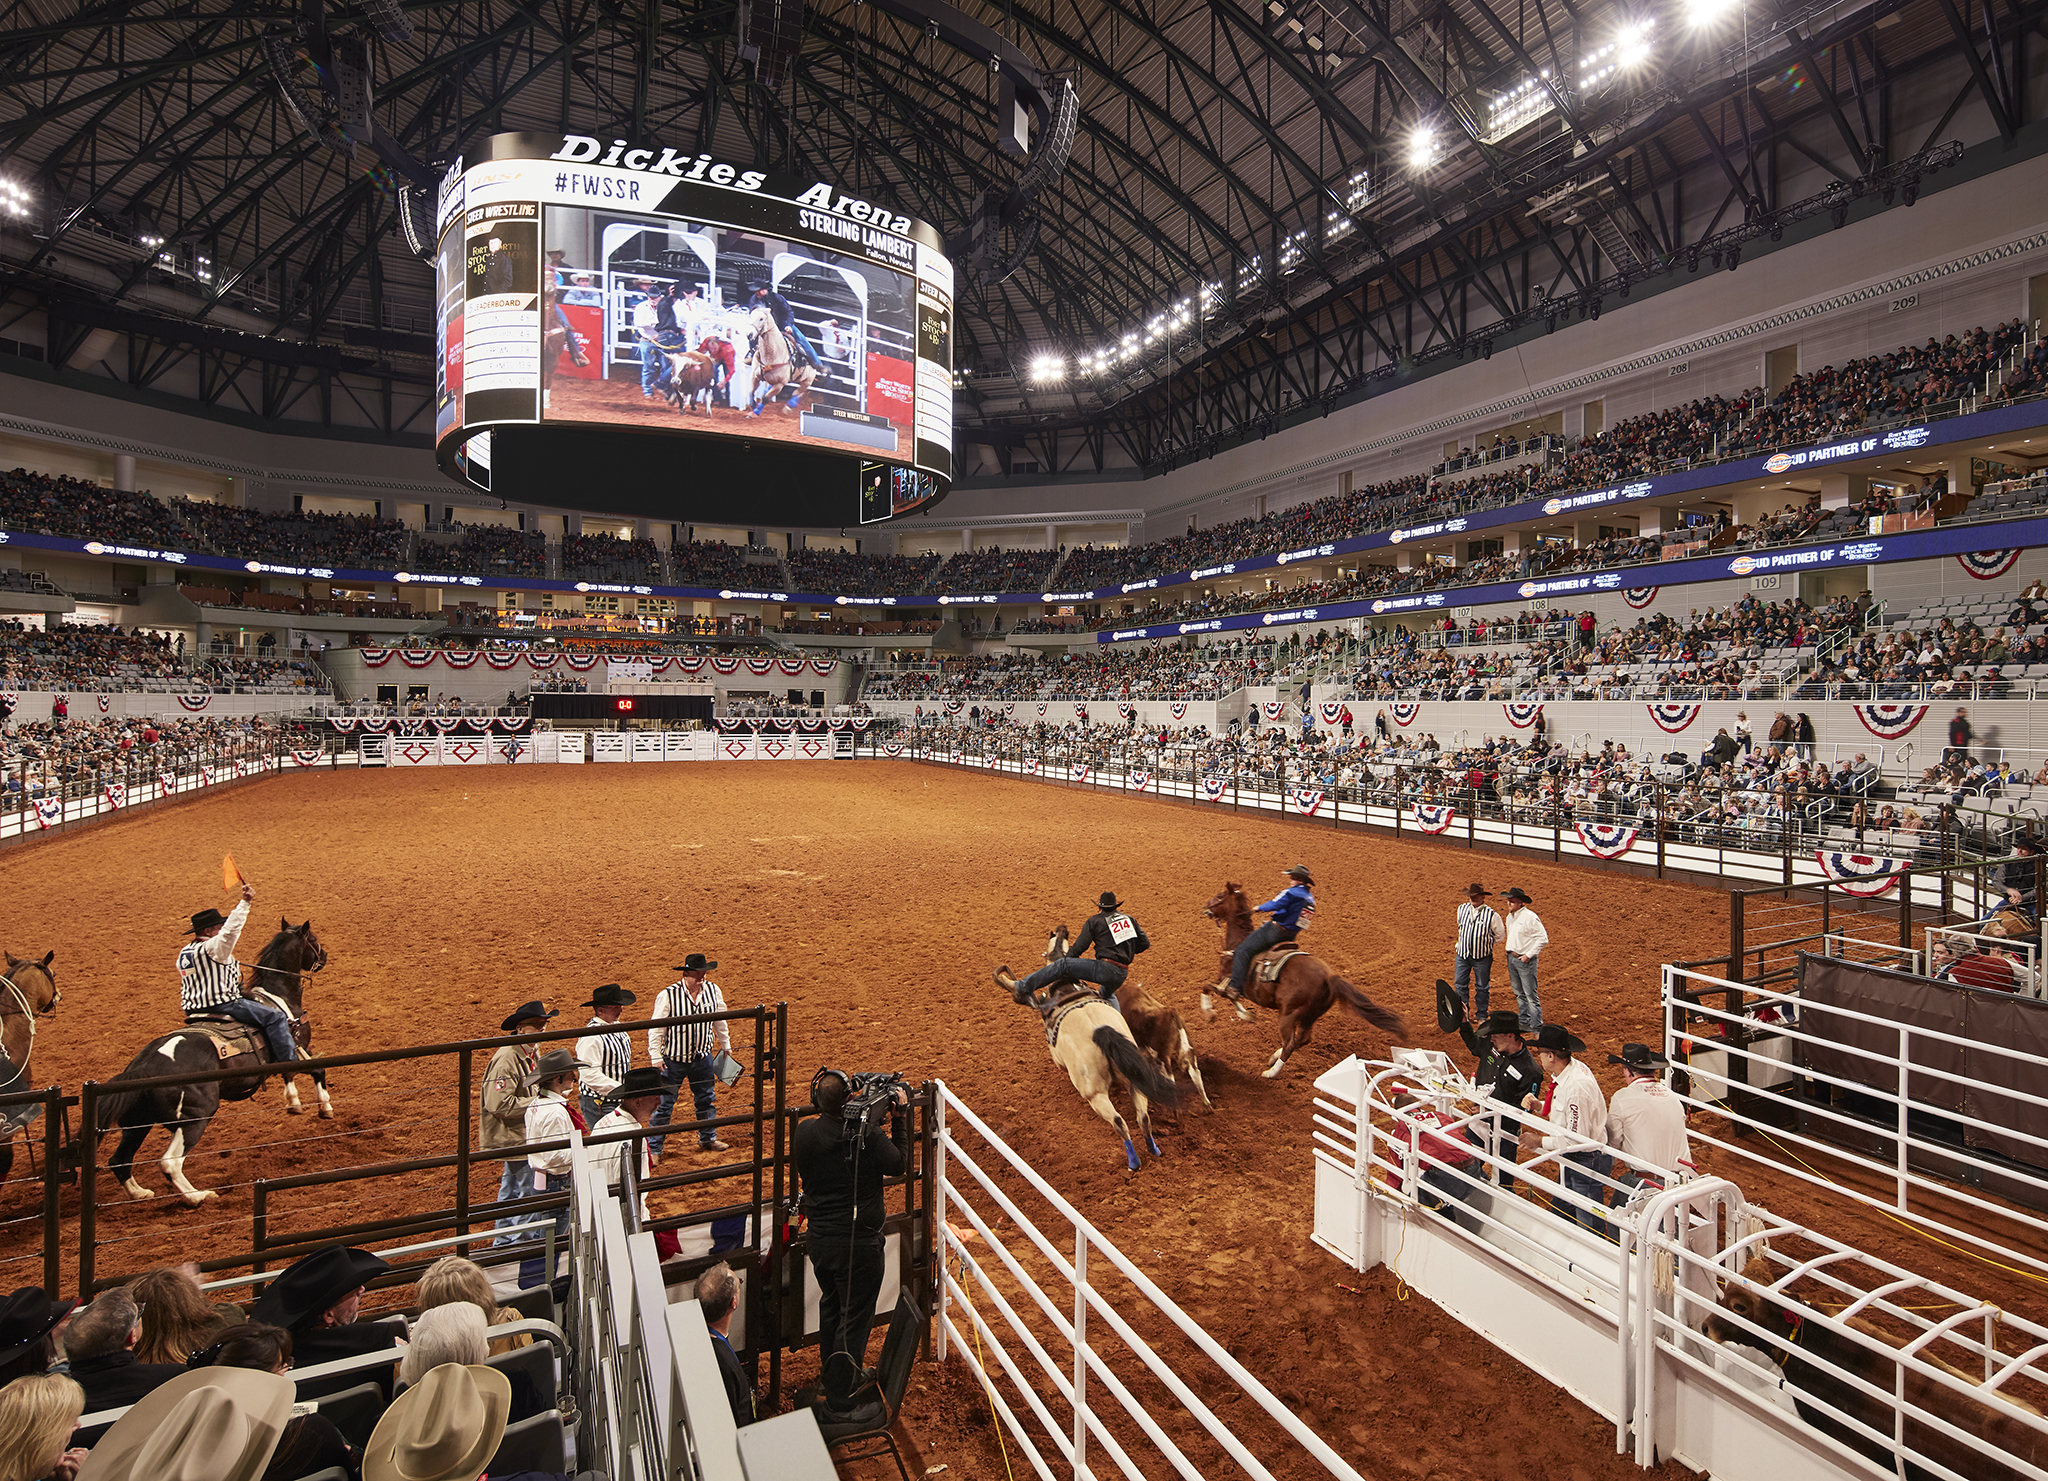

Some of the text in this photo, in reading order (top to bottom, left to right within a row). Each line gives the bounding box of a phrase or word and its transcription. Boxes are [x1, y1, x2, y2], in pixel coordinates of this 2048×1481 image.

[549, 134, 912, 235] Dickies Arena
[555, 172, 640, 201] #FWSSR
[485, 204, 535, 218] WRESTLING
[799, 209, 914, 260] STERLING LAMBERT
[468, 253, 490, 269] STOC
[889, 256, 913, 270] Nevada
[474, 299, 521, 311] LEADERBOARD
[1892, 296, 1915, 311] 209
[1670, 363, 1687, 375] 208
[1511, 411, 1523, 421] 207
[1883, 431, 1930, 445] STOCK SHOW
[1809, 442, 1859, 462] PARTNER
[1861, 438, 1877, 452] OF
[1573, 492, 1606, 507] PARTNER
[1608, 489, 1619, 500] OF
[1411, 525, 1435, 538] PARTNER
[1436, 524, 1444, 533] OF
[116, 546, 148, 558] PARTNER
[149, 550, 159, 559] OF
[1772, 551, 1818, 567] PARTNER
[1820, 549, 1835, 561] OF
[270, 565, 297, 575] PARTNER
[421, 574, 448, 583] PARTNER
[1548, 580, 1579, 592] PARTNER
[1580, 578, 1590, 588] OF
[1755, 577, 1777, 589] 109
[1393, 598, 1414, 609] PARTNER
[1531, 600, 1546, 609] 108
[1456, 607, 1469, 617] 107
[1111, 920, 1130, 934] 214
